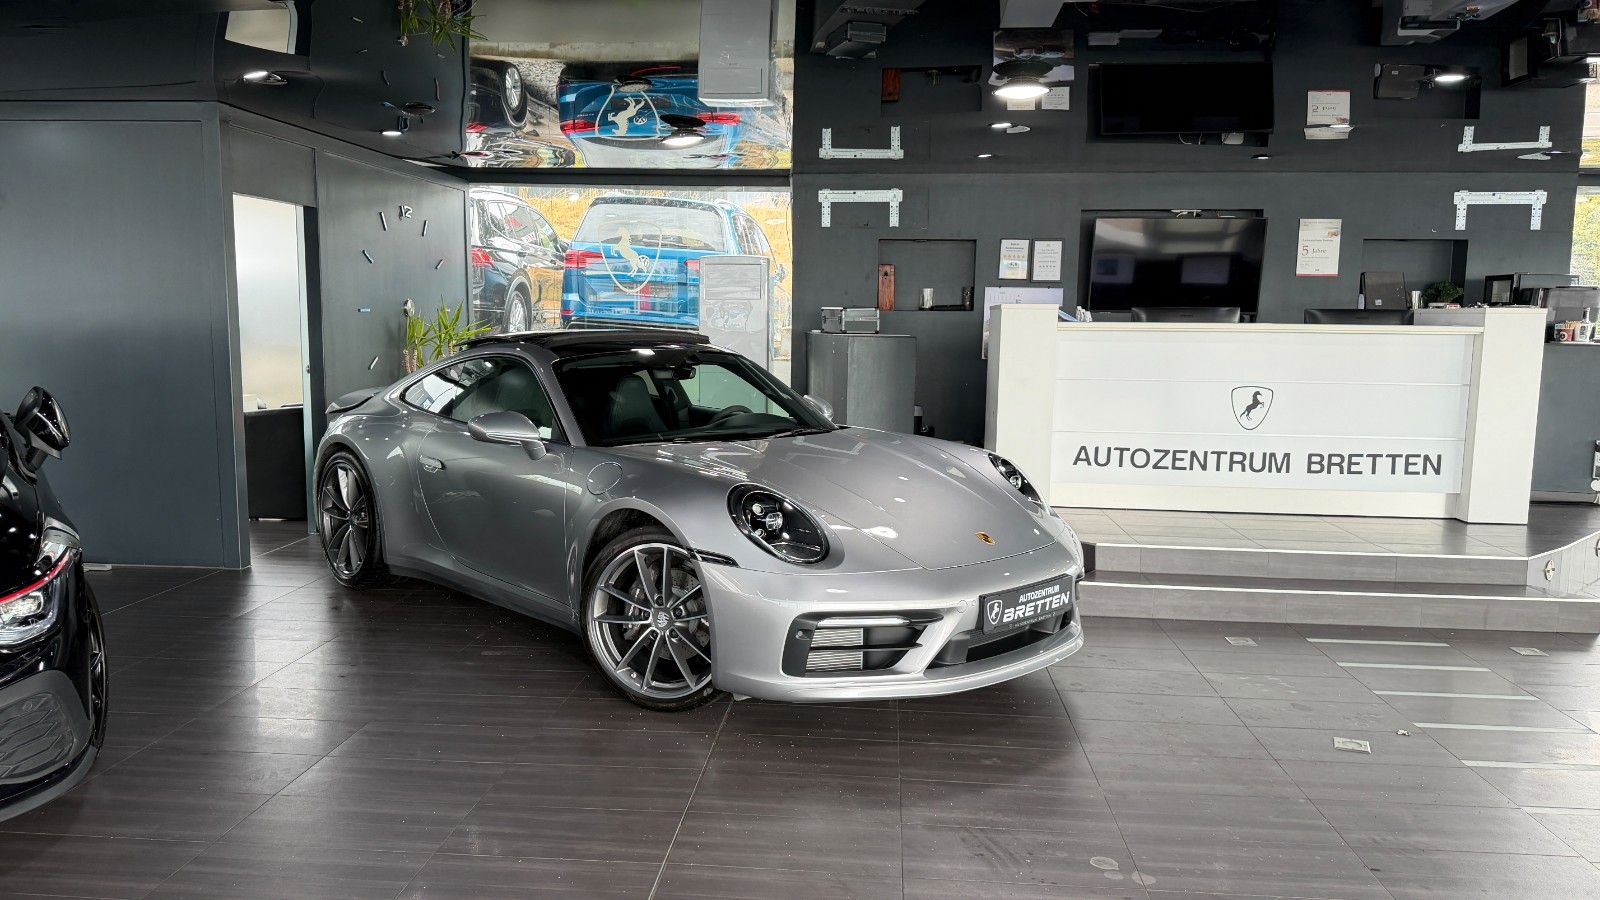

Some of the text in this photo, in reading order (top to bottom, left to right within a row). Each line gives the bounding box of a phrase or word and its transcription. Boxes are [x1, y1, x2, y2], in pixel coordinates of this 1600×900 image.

[400, 205, 413, 219] 12
[1302, 245, 1309, 256] 5
[1072, 445, 1442, 476] AUTOZENTRUM BRETTEN
[1018, 584, 1060, 603] AUTOZENTRUM
[1002, 591, 1070, 622] BRETTEN
